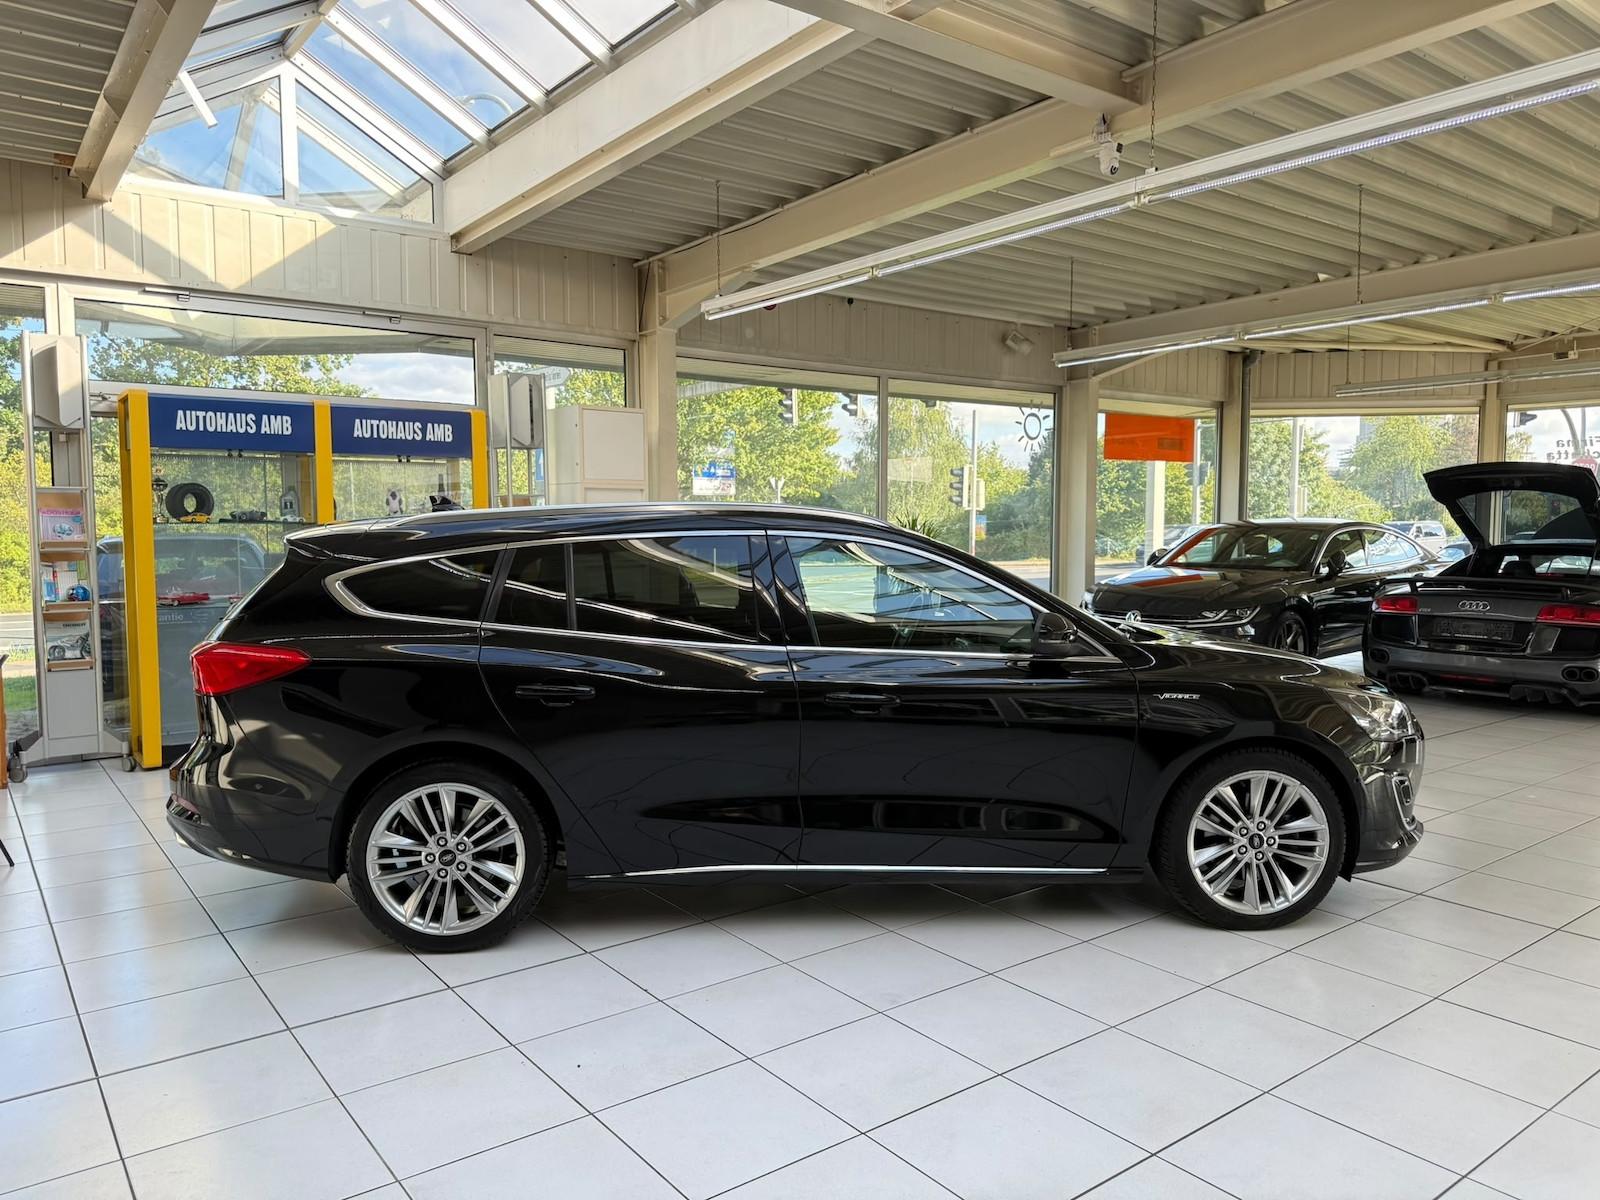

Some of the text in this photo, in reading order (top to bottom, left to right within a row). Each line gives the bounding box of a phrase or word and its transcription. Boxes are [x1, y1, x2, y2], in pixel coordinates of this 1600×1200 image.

[176, 409, 292, 435] AUTOHAUS AMB
[353, 418, 453, 442] AUTOHAUS AMB
